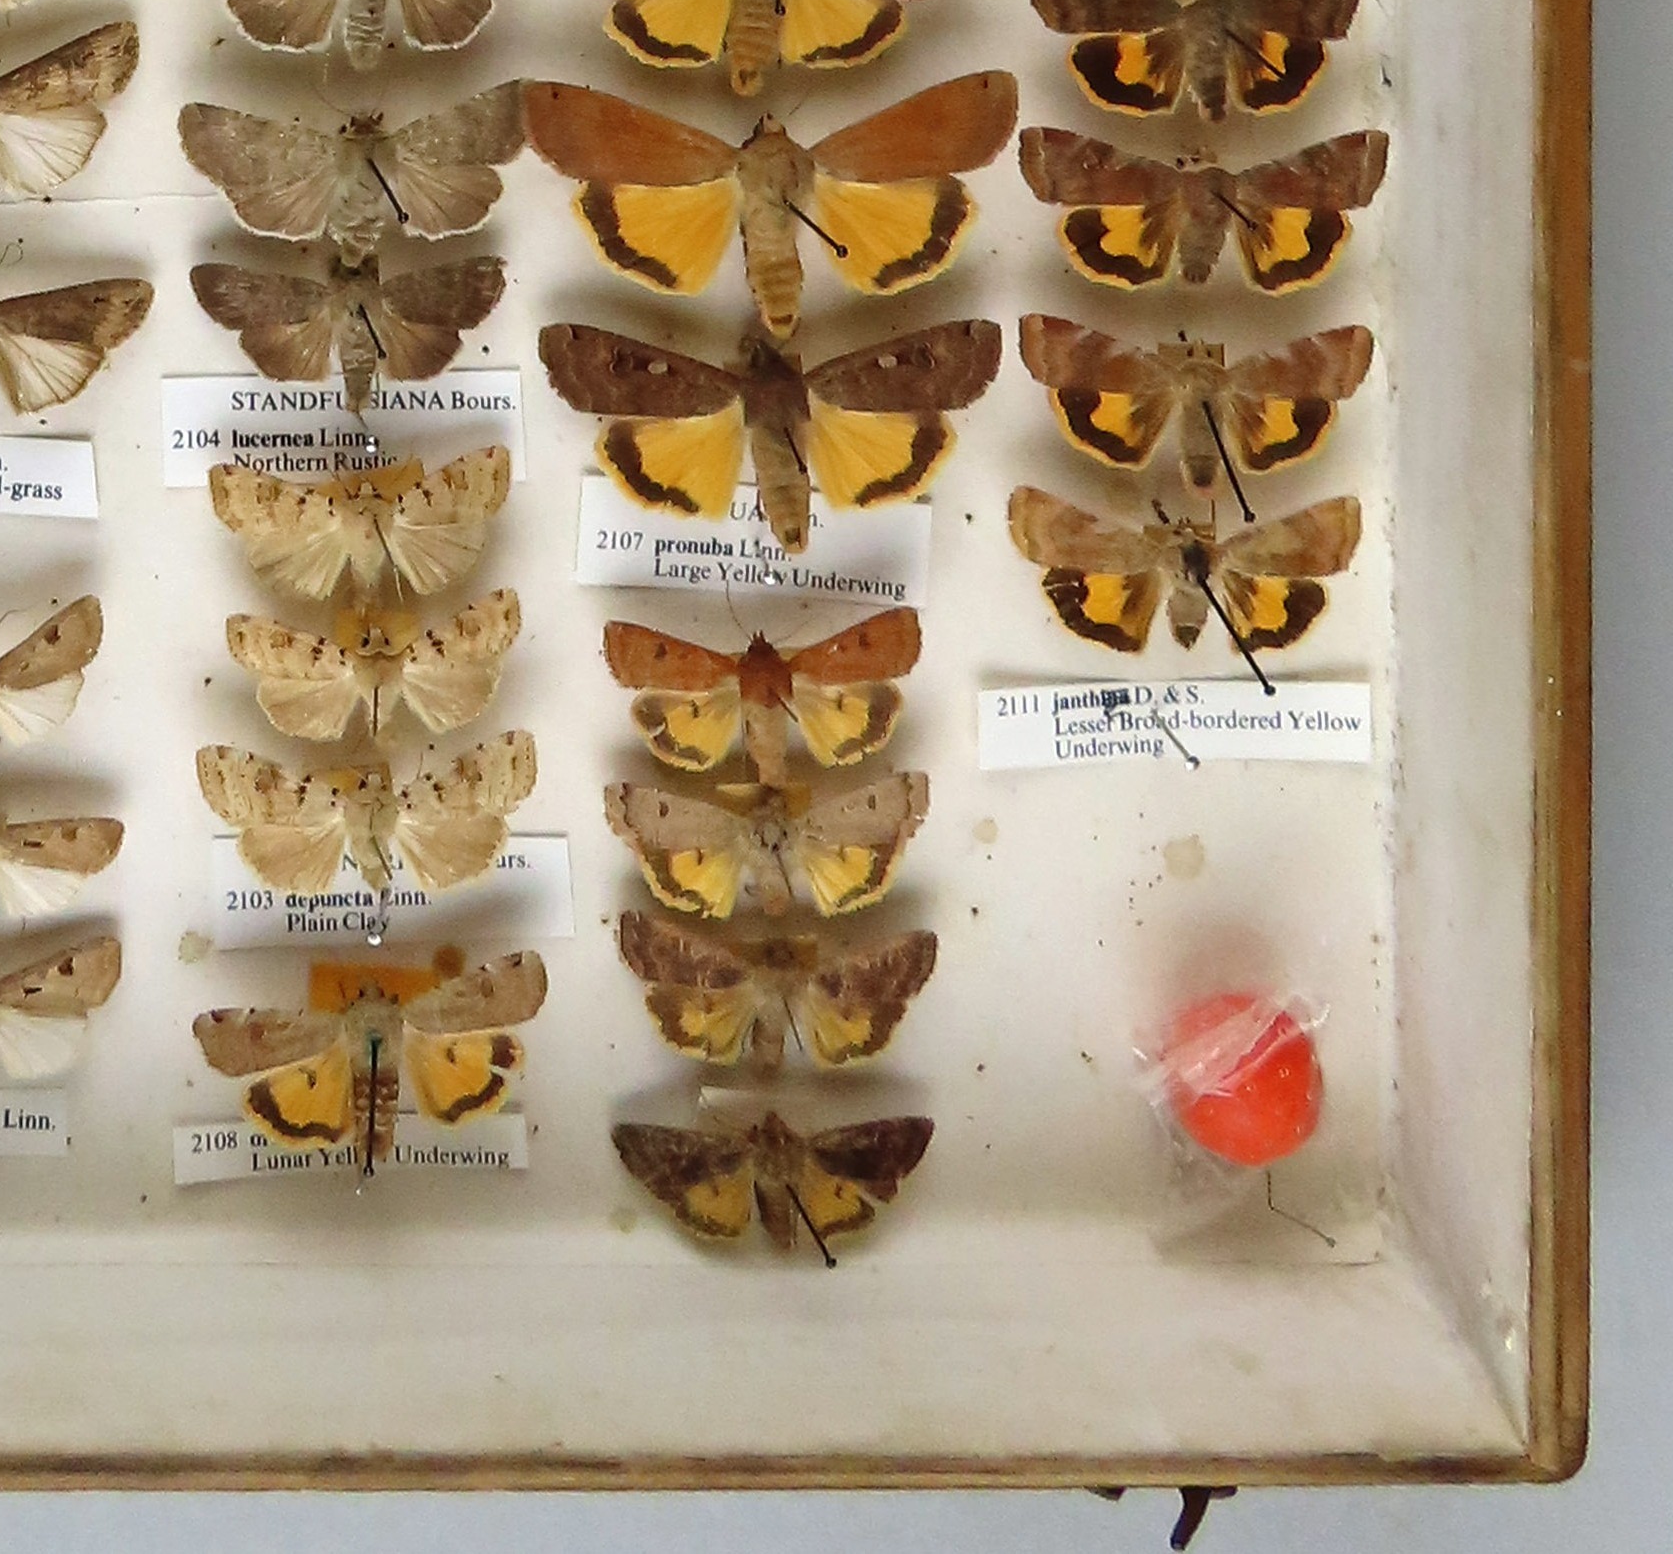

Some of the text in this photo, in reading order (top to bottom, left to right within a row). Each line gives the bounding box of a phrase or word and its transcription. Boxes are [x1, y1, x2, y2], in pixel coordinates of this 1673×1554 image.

[451, 393, 515, 411] Bours.
[173, 429, 314, 448] 2104 lucernea
[597, 532, 734, 557] 2107 pronuba
[654, 559, 905, 599] Large Underwing
[997, 695, 1040, 715] 2111
[1164, 688, 1181, 703] &
[1186, 686, 1205, 704] S.
[1287, 712, 1361, 730] Yellow
[1056, 738, 1164, 759] Underwing
[227, 892, 273, 909] 2103
[288, 913, 338, 931] Plain
[4, 1109, 55, 1130] Linn.
[192, 1134, 237, 1152] 2108
[395, 1145, 509, 1167] Underwing
